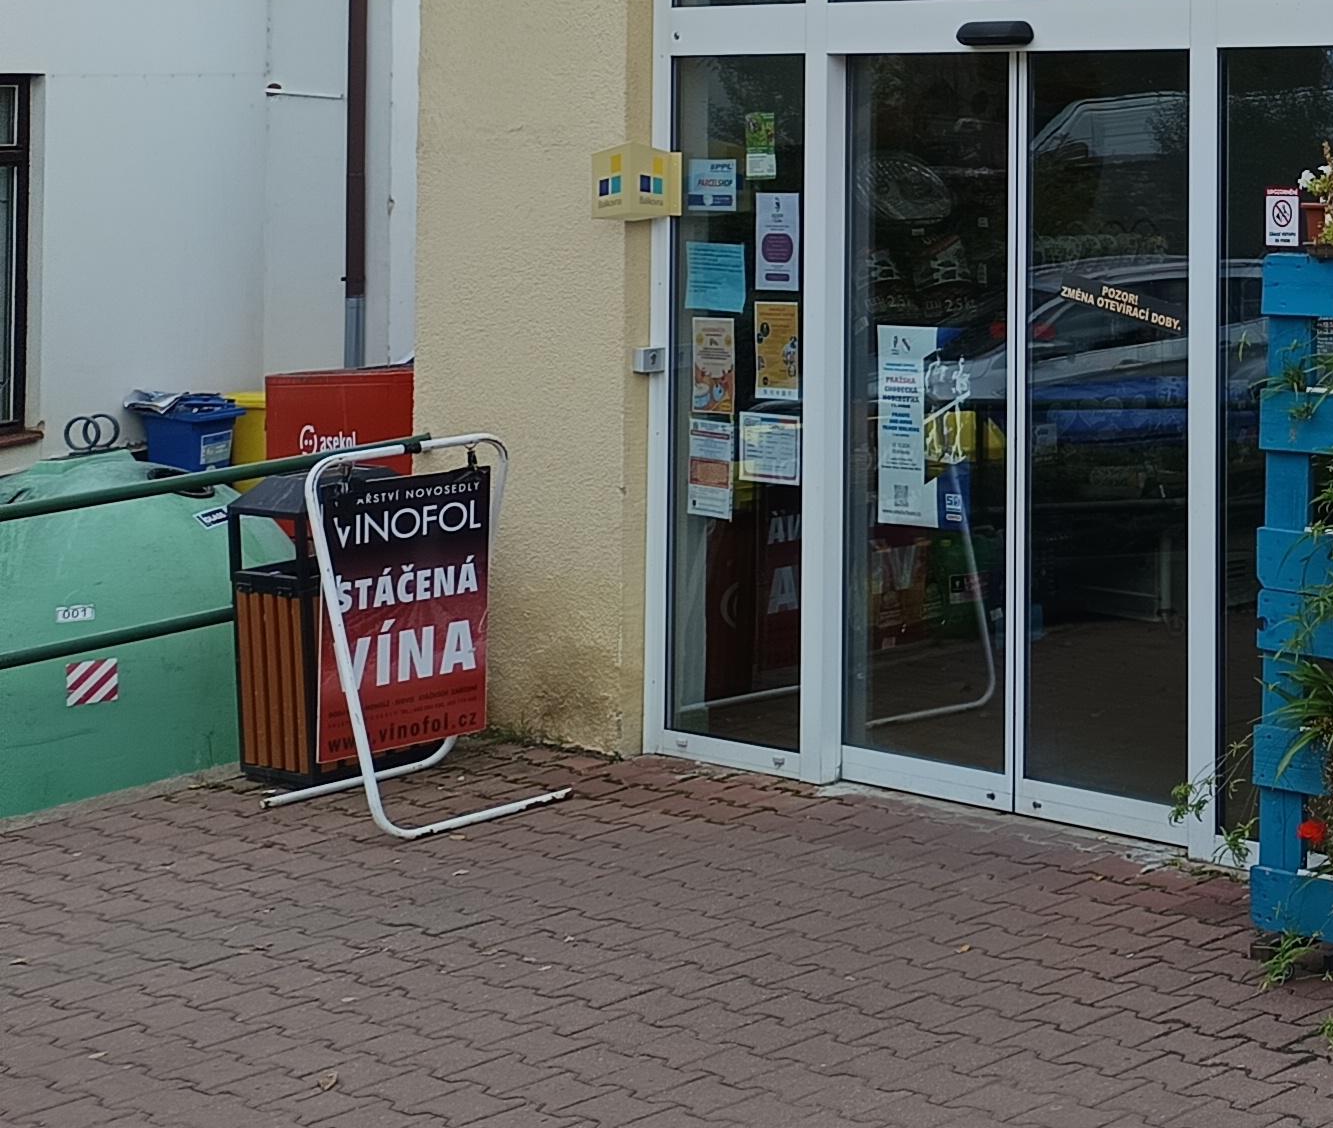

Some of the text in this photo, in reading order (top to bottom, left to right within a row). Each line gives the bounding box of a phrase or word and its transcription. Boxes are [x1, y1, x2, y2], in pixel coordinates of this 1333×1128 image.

[1061, 286, 1181, 330] ZMĚNA OTEVÍRACÍ DOBY.
[1101, 286, 1139, 305] POZOR!
[405, 482, 480, 500] NOVOSEDLY
[333, 500, 481, 549] VINOFOL
[335, 554, 478, 613] STÁČENÁ
[62, 607, 87, 620] 001
[333, 618, 477, 692] VÍNA
[328, 712, 478, 753] ww.vinofol.cz
